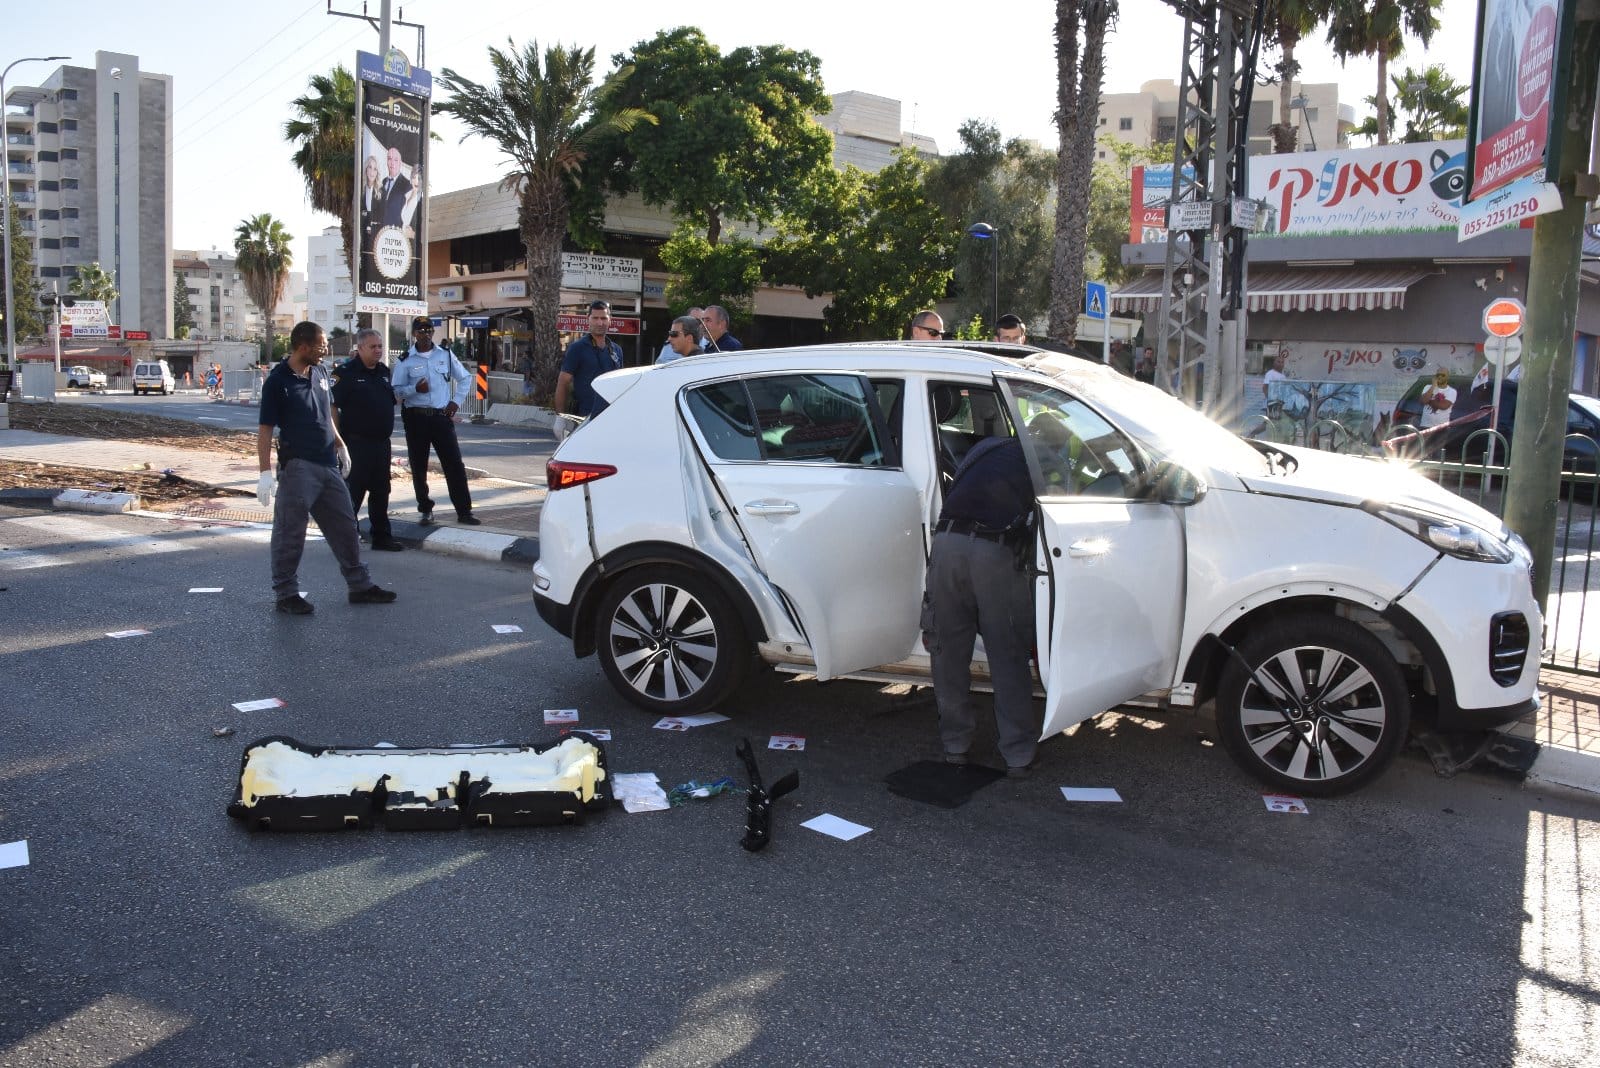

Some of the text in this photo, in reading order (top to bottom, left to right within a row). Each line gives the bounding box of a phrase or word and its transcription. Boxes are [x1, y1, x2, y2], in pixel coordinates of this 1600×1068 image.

[369, 116, 420, 135] GET MAXIMUM
[1464, 197, 1539, 236] 055-2251250
[384, 237, 402, 247] אמינות
[610, 264, 639, 274] משרד
[365, 281, 418, 297] 050-5077258
[362, 304, 422, 315] 055-2251250
